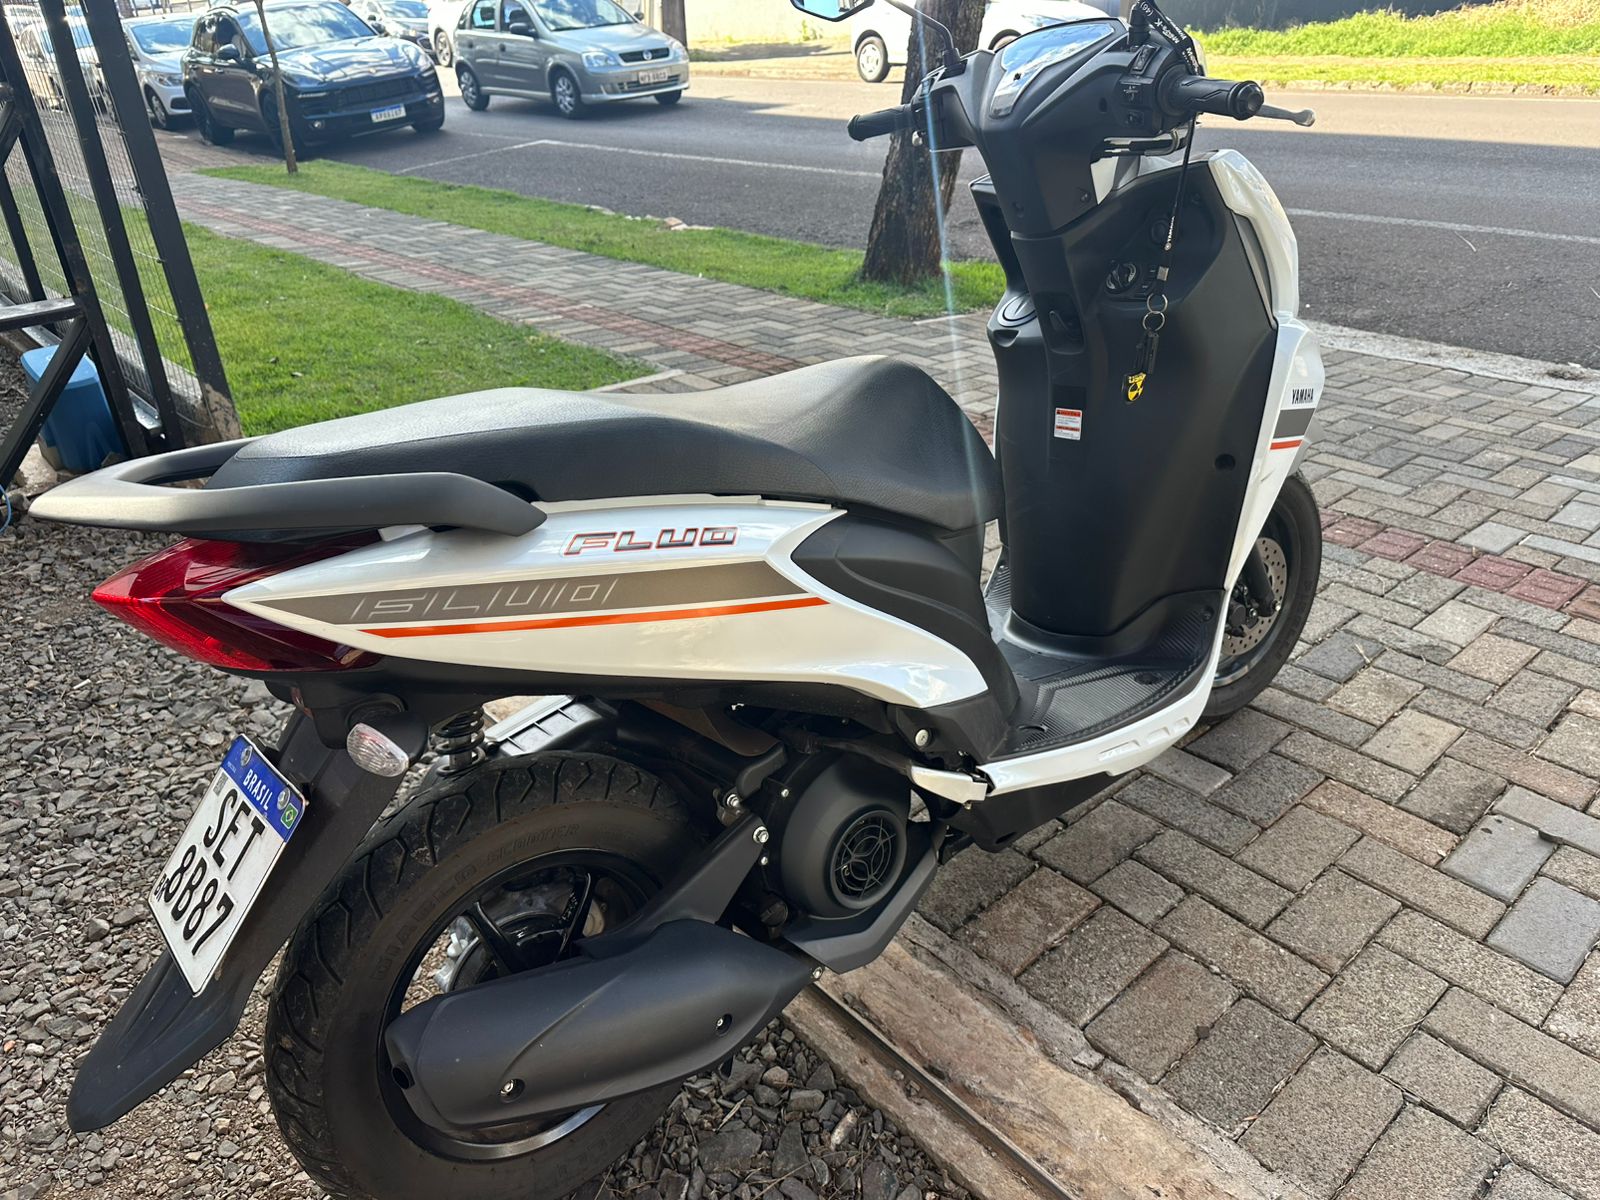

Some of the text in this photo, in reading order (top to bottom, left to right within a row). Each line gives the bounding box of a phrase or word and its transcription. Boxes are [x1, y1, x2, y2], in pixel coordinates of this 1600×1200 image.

[1292, 388, 1313, 404] YAMAHA
[563, 526, 738, 556] FLUO
[365, 582, 604, 620] FLUO
[243, 769, 273, 811] BRASIL
[203, 788, 265, 882] SET
[163, 845, 234, 957] 8B87
